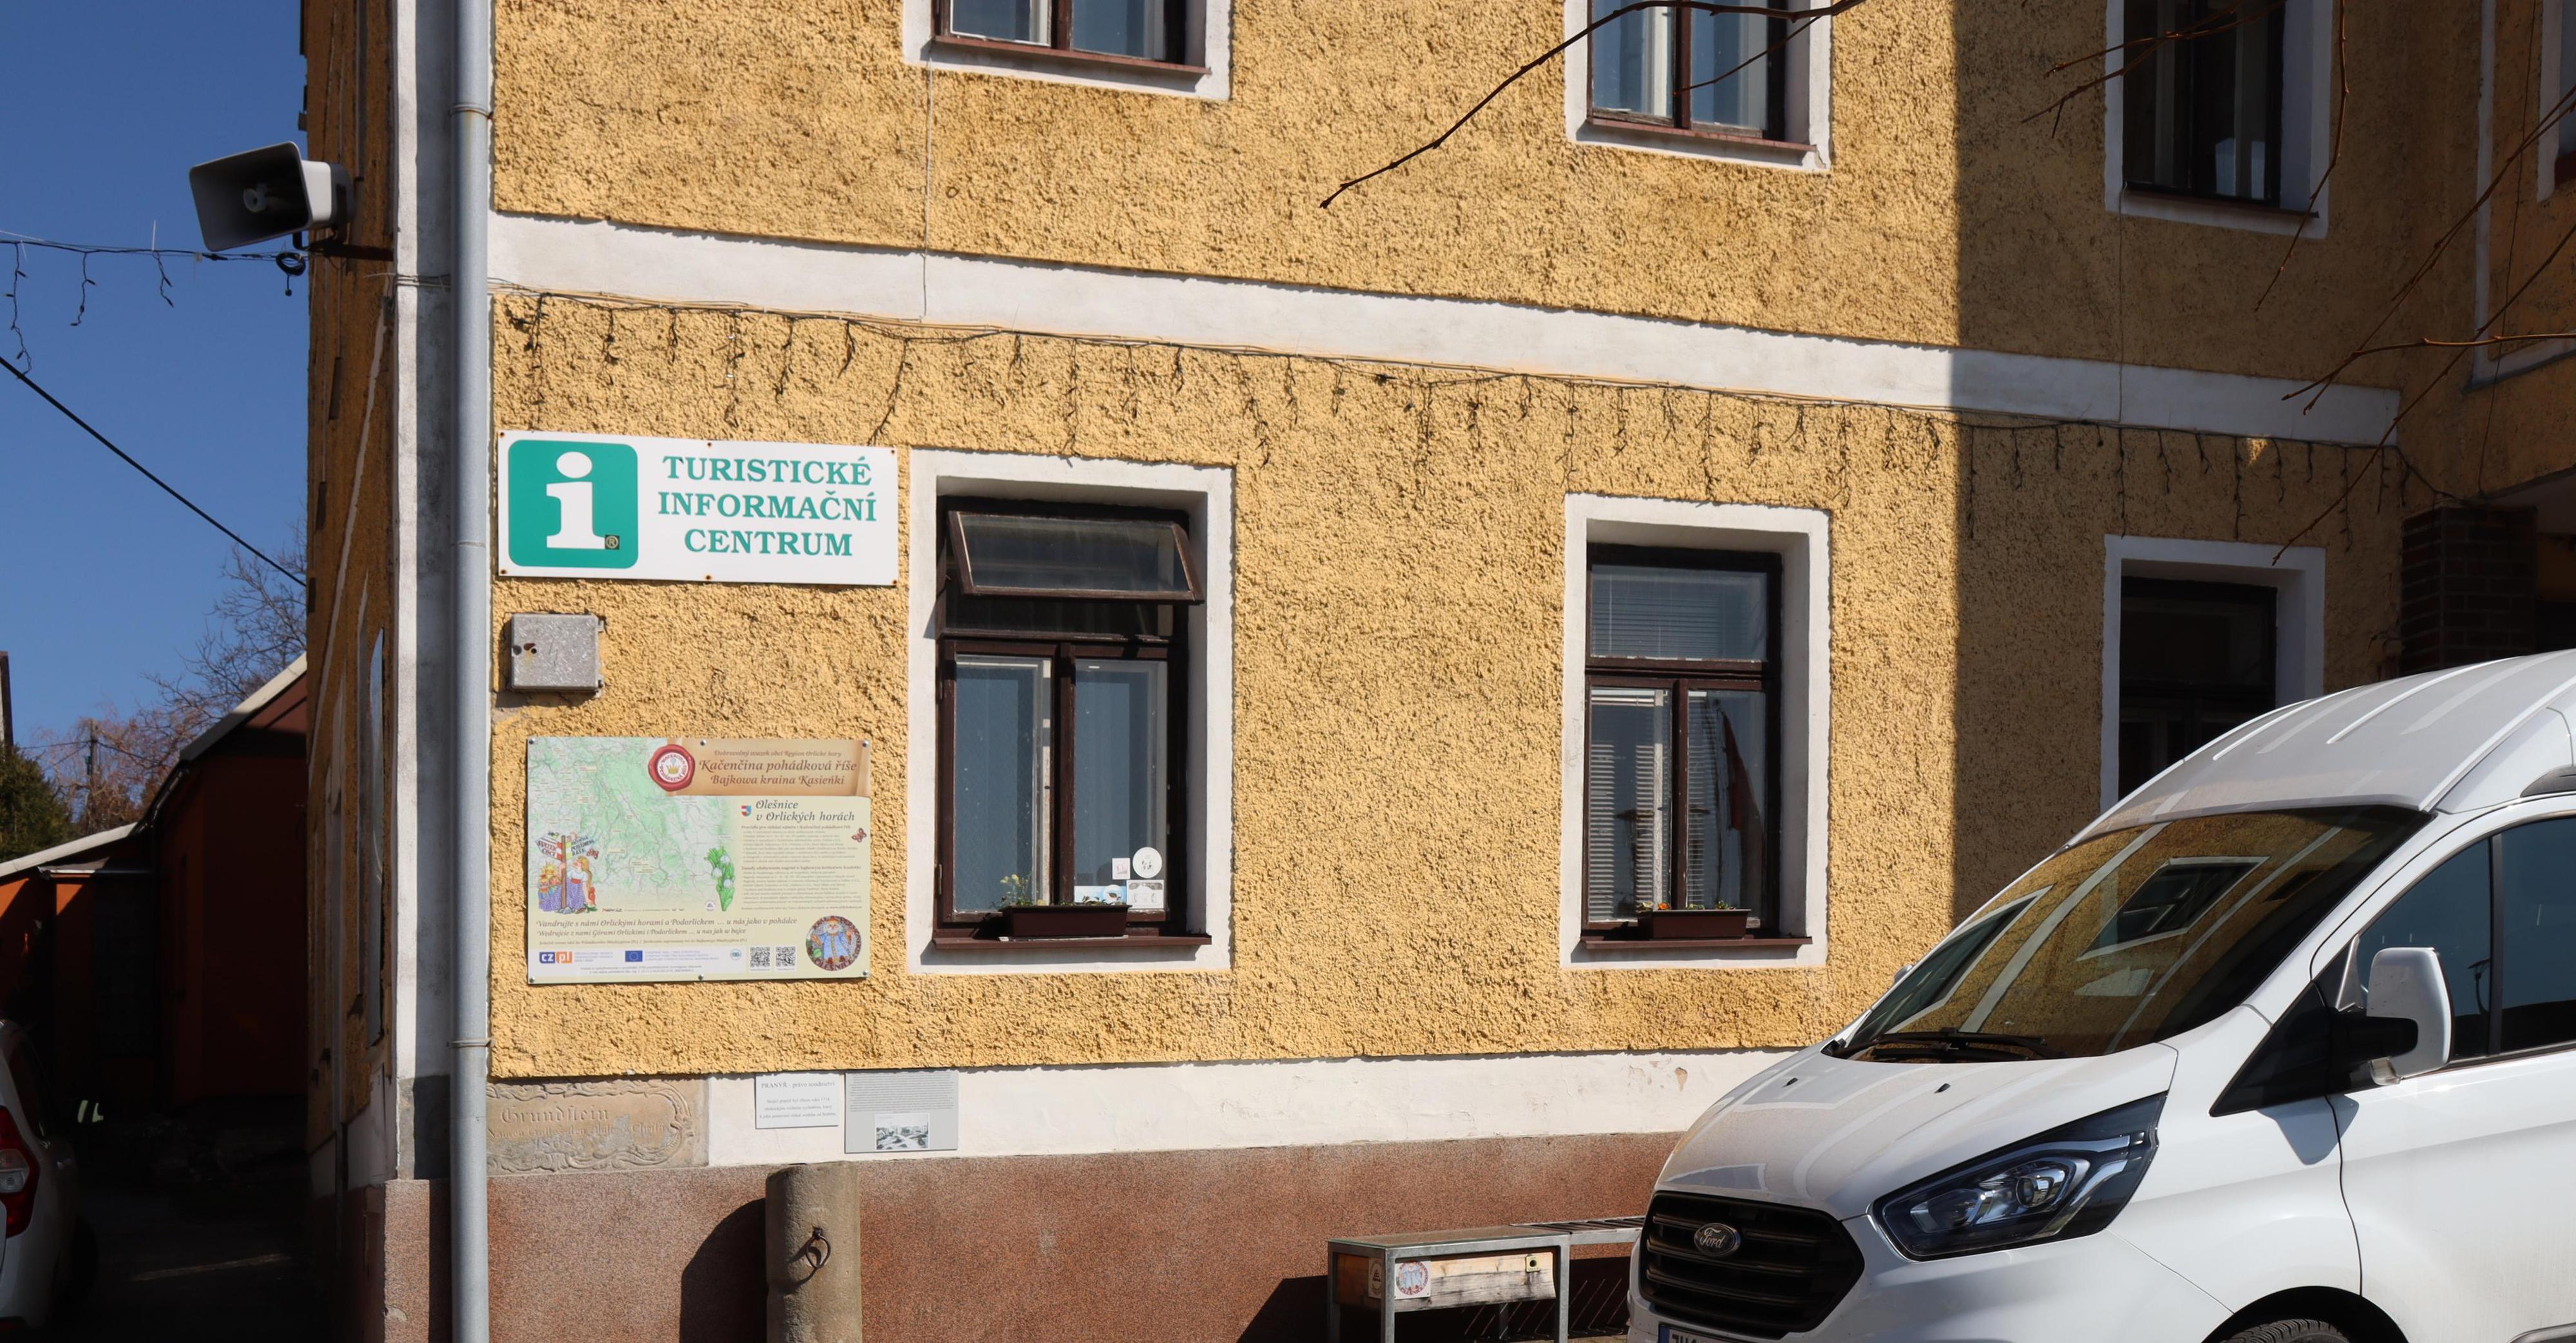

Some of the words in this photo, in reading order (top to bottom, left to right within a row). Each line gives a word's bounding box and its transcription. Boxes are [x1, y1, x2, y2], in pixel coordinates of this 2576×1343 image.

[662, 455, 872, 486] TURISTICKÉ
[658, 490, 877, 522] INFORMAČNÍ
[684, 528, 853, 557] CENTRUM
[699, 759, 764, 773] Kačenčina
[766, 759, 832, 773] pohádková
[835, 760, 858, 771] říše
[710, 774, 757, 786] Bajkowa
[760, 775, 795, 785] kraina
[799, 775, 845, 787] Kasieńki
[755, 799, 799, 810] Olešnice
[766, 812, 815, 823] Orlických
[819, 811, 855, 821] horách
[536, 920, 574, 928] Vandrujte
[600, 919, 636, 928] Orlickými
[745, 917, 762, 926] jako
[768, 917, 798, 926] pohádce
[592, 929, 616, 938] Górami
[731, 927, 747, 935] bajce
[541, 953, 554, 962] cz
[558, 951, 571, 964] pl
[501, 1105, 609, 1123] Grundstein
[1699, 1226, 1727, 1248] Ford
